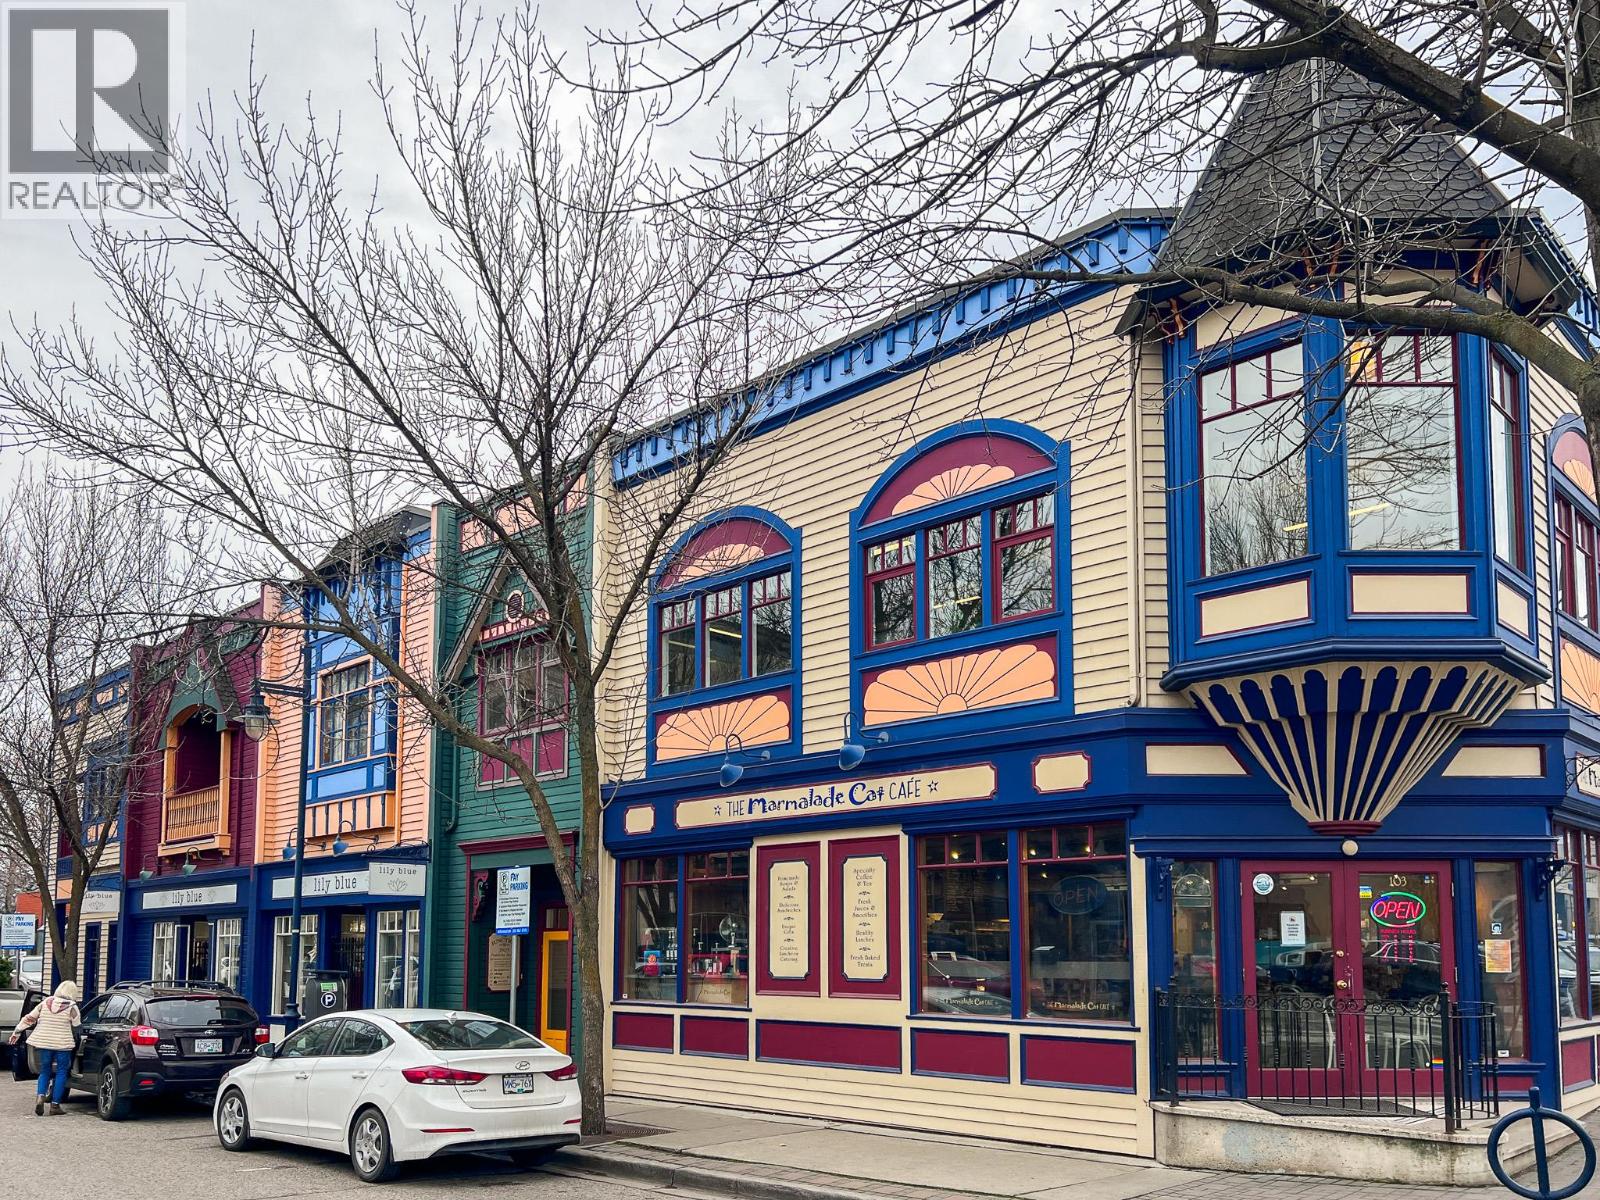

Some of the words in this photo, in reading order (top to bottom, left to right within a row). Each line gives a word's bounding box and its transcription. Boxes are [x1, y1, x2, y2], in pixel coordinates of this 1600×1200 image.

[726, 800, 745, 817] THE
[849, 782, 884, 807] Cat
[889, 777, 921, 800] CAFÉ
[379, 866, 395, 875] lily
[398, 867, 417, 875] blue
[314, 877, 331, 894] lily
[335, 876, 357, 890] blue
[1389, 874, 1407, 887] 103
[172, 892, 184, 905] lily
[187, 891, 203, 903] blue
[1054, 886, 1098, 905] OPEN
[1373, 901, 1421, 919] OPEN
